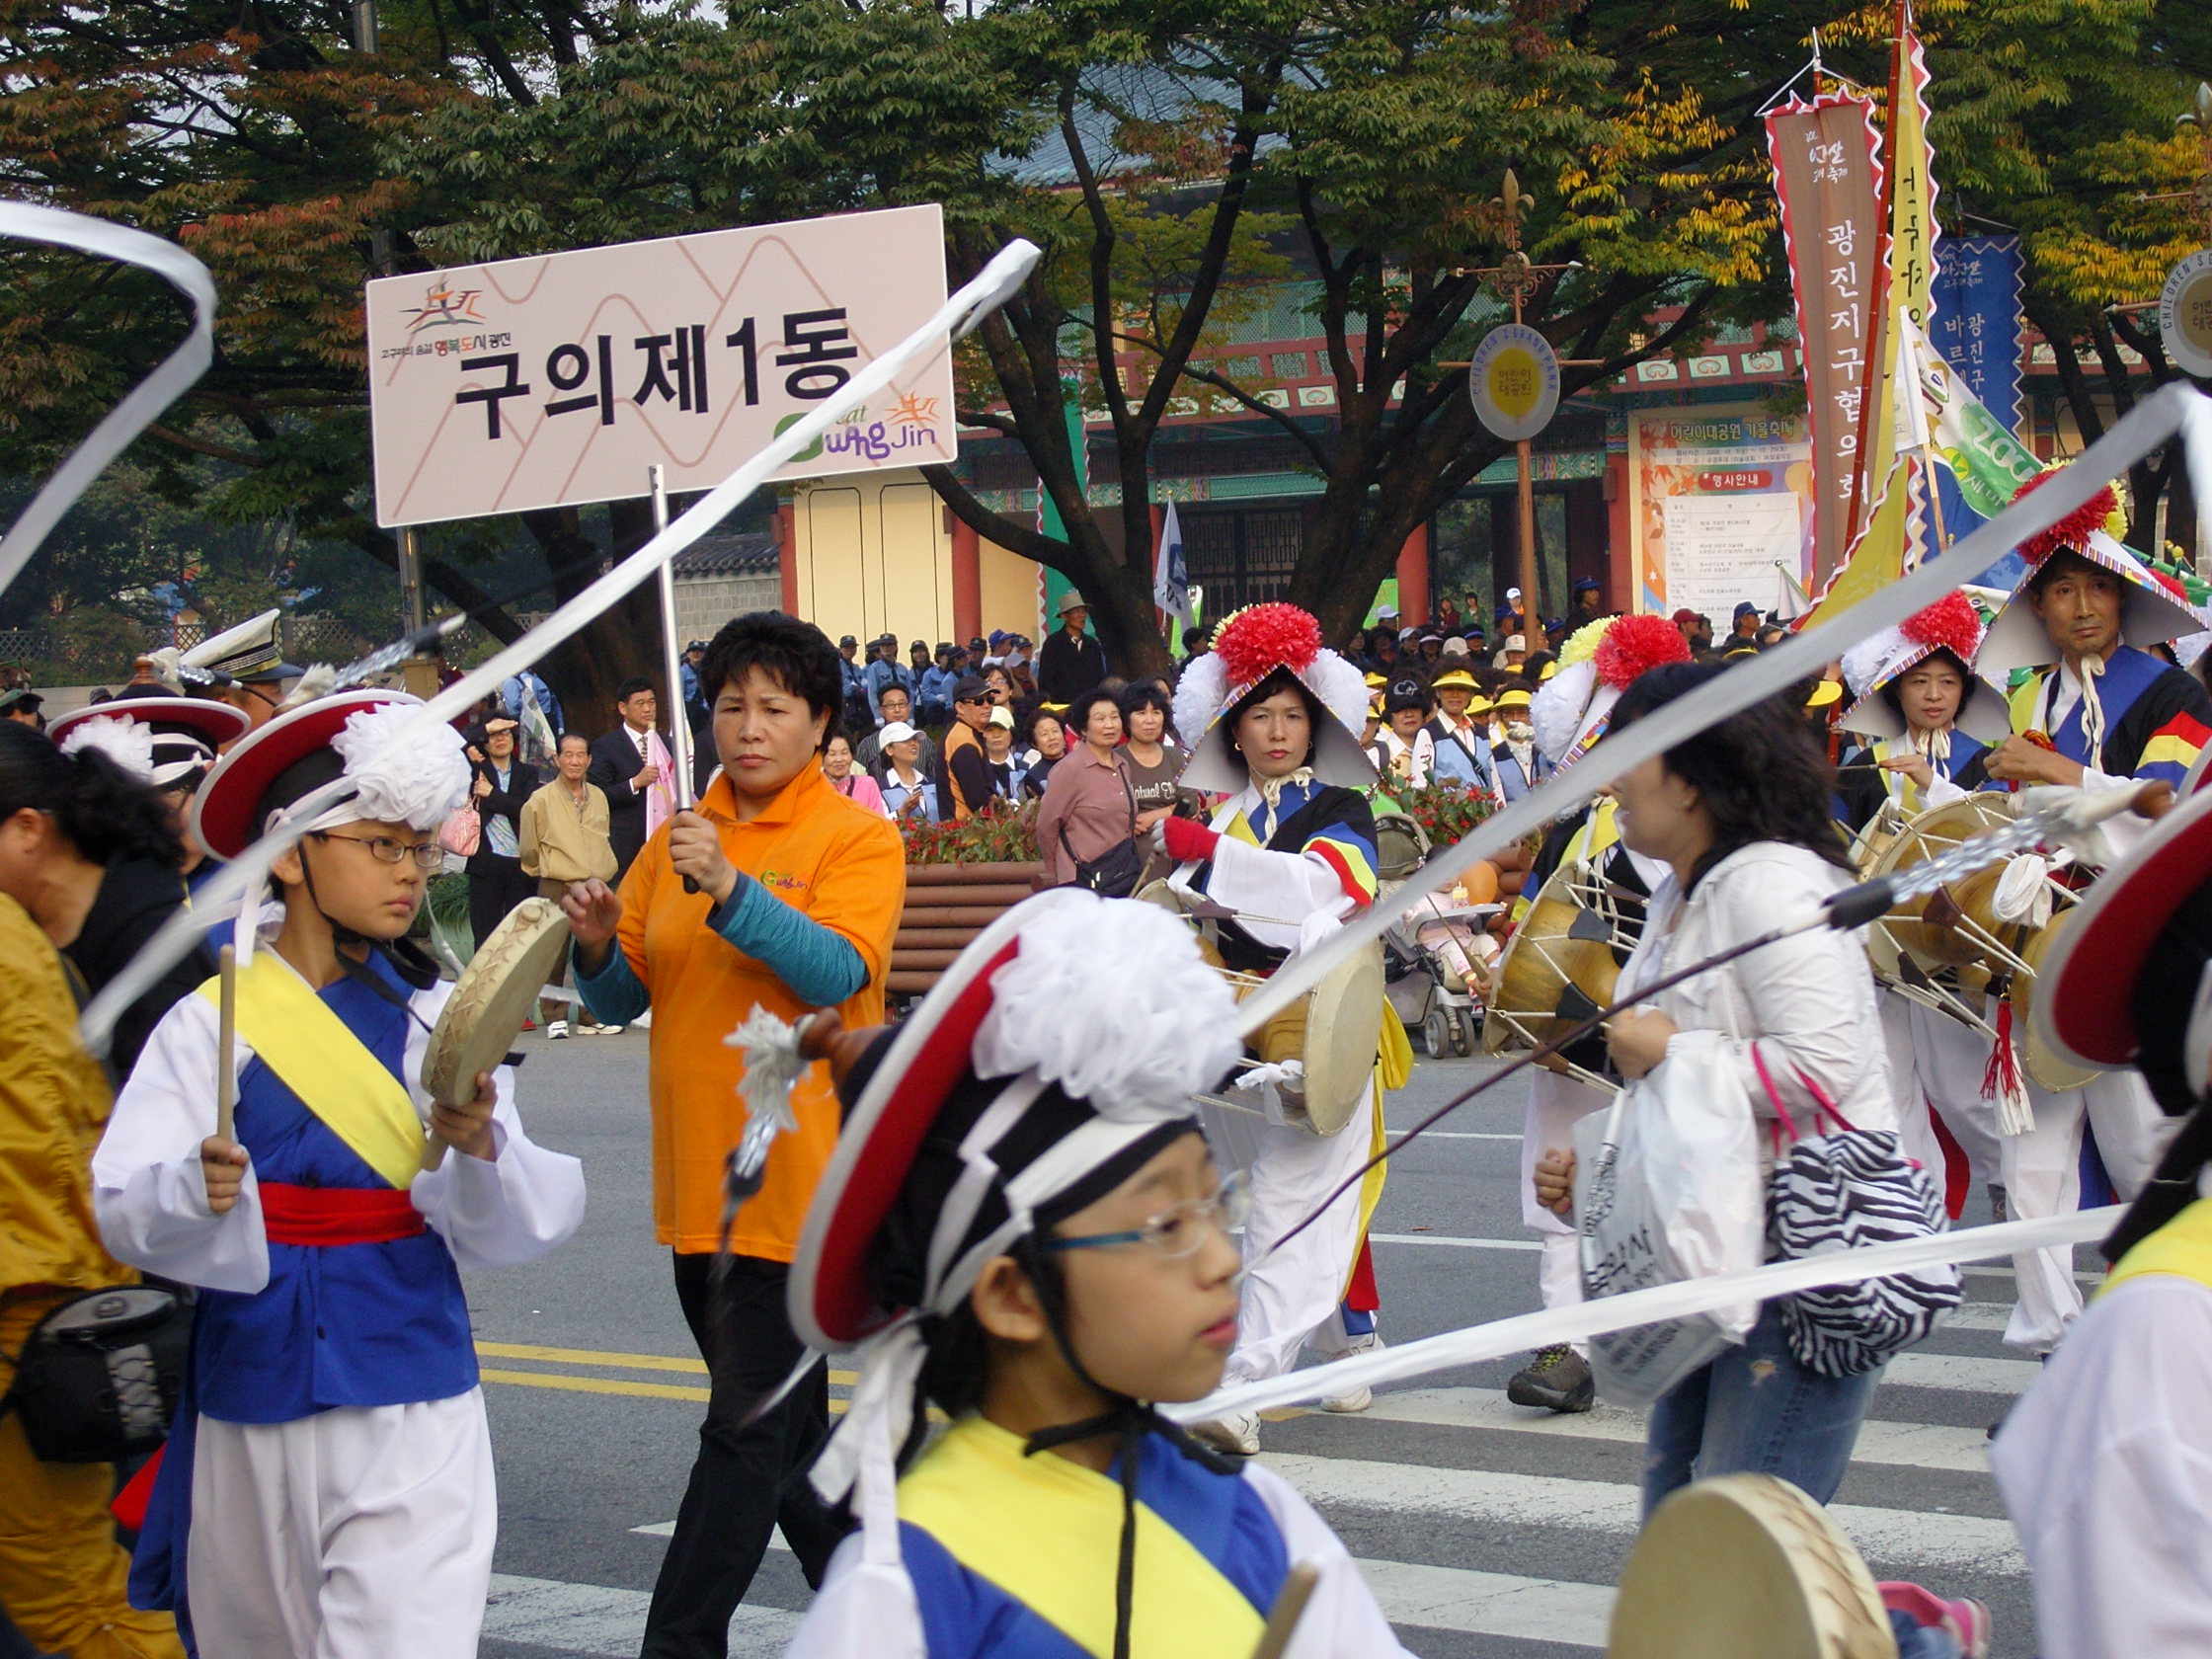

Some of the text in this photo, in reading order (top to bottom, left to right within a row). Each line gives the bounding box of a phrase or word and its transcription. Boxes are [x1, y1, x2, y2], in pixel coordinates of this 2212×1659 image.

[434, 334, 486, 356] 행복도시
[1968, 313, 1986, 406] 광진구
[455, 306, 858, 440] 구의제1동
[1670, 419, 1794, 442] 어린이대공원 가을축제
[1712, 473, 1759, 488] 행사안내
